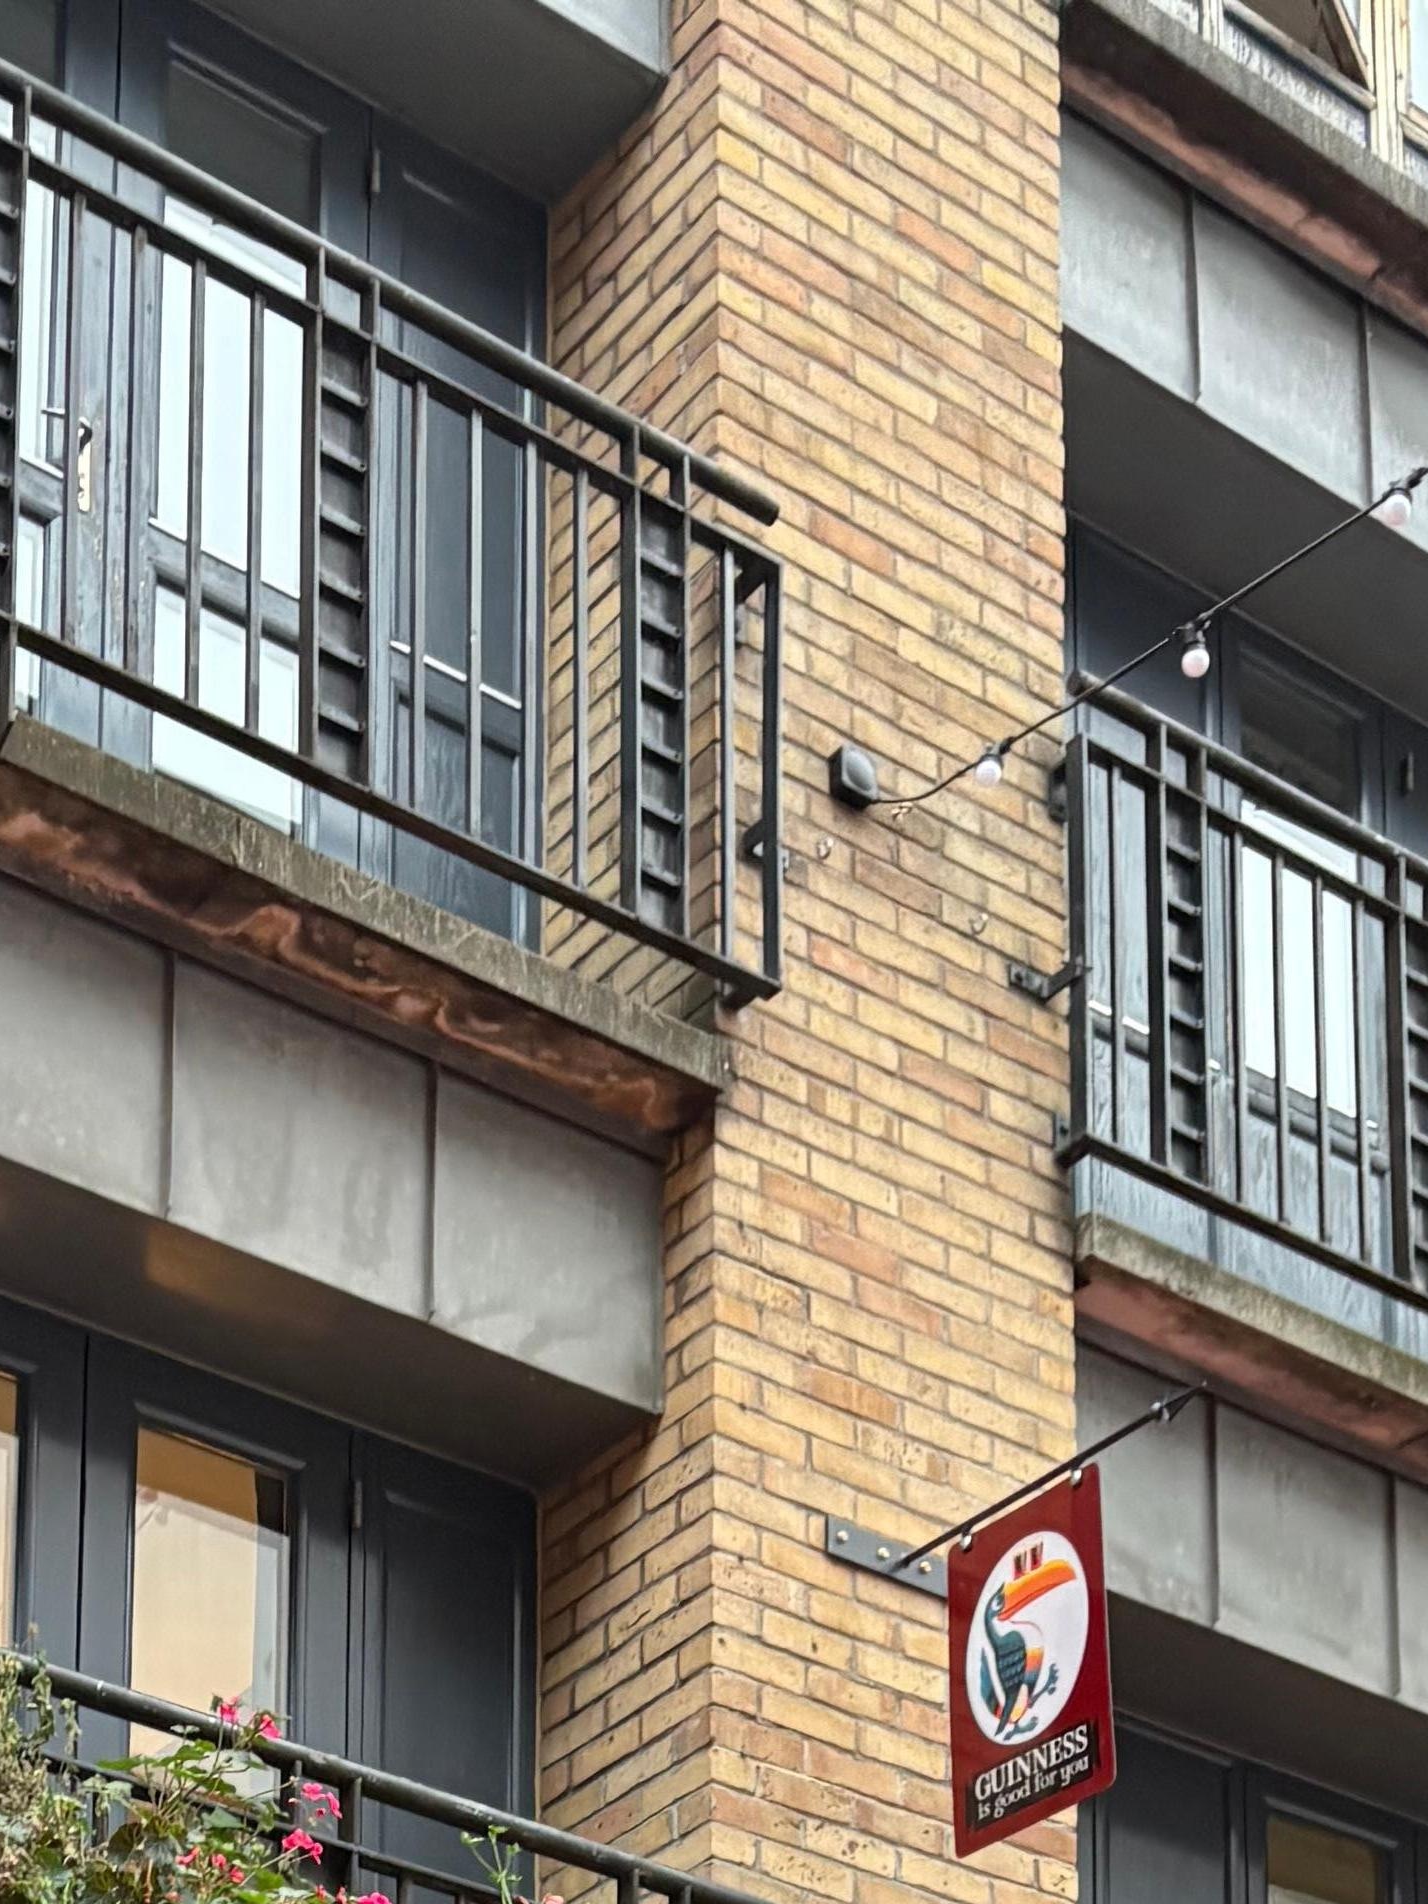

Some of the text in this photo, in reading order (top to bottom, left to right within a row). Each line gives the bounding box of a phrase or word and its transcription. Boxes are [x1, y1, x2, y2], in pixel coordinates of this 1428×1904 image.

[974, 1724, 1089, 1802] GUINNESS
[977, 1755, 1089, 1821] is good for you
